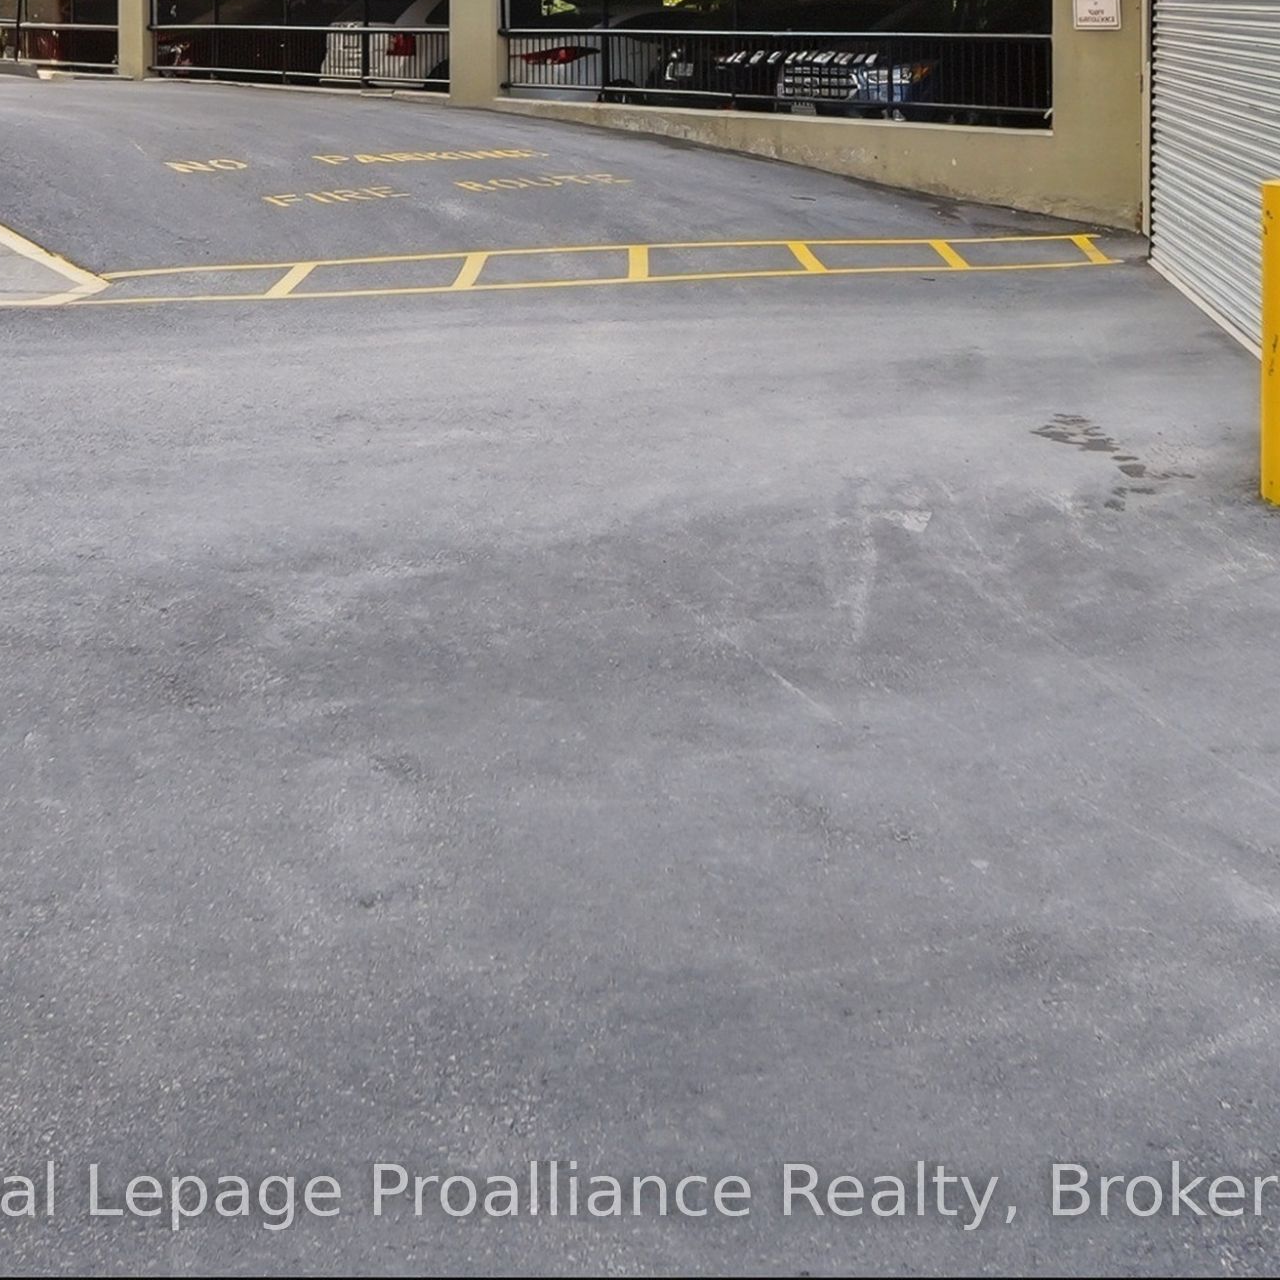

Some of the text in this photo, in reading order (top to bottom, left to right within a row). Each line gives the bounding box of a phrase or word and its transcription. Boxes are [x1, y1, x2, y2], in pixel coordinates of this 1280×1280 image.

[164, 158, 248, 173] NO
[262, 174, 633, 207] FIRE ROUTE
